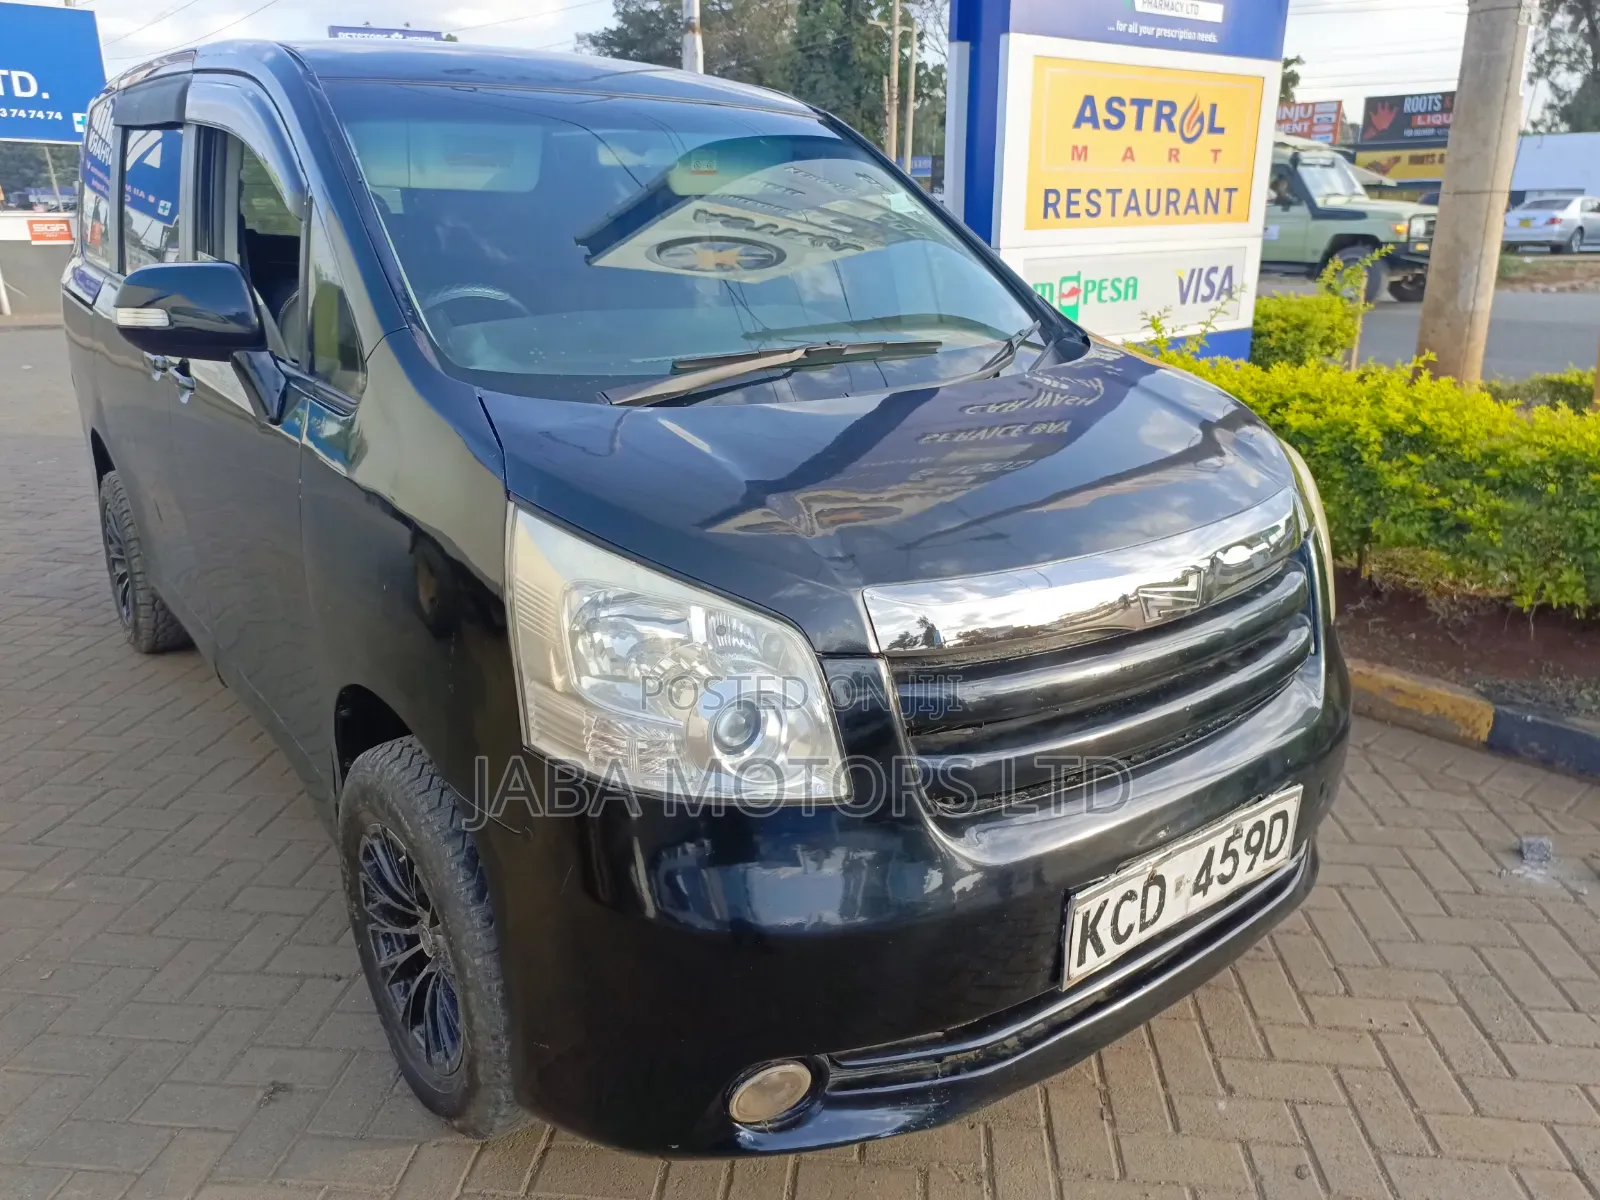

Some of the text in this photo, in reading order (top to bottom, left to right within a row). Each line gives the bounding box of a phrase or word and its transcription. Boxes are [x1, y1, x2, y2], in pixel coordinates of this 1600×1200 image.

[1186, 4, 1200, 16] LTD
[1116, 20, 1128, 32] for
[1128, 22, 1138, 34] all
[1139, 25, 1155, 37] your
[1156, 27, 1197, 42] prescription
[1404, 94, 1442, 113] ROOTS
[1072, 93, 1226, 144] ASTROL
[1071, 144, 1222, 164] MART
[1042, 187, 1238, 219] RESTAURANT
[32, 223, 68, 232] SGA
[1176, 265, 1234, 306] VISA
[1076, 809, 1290, 968] KCD 459D
